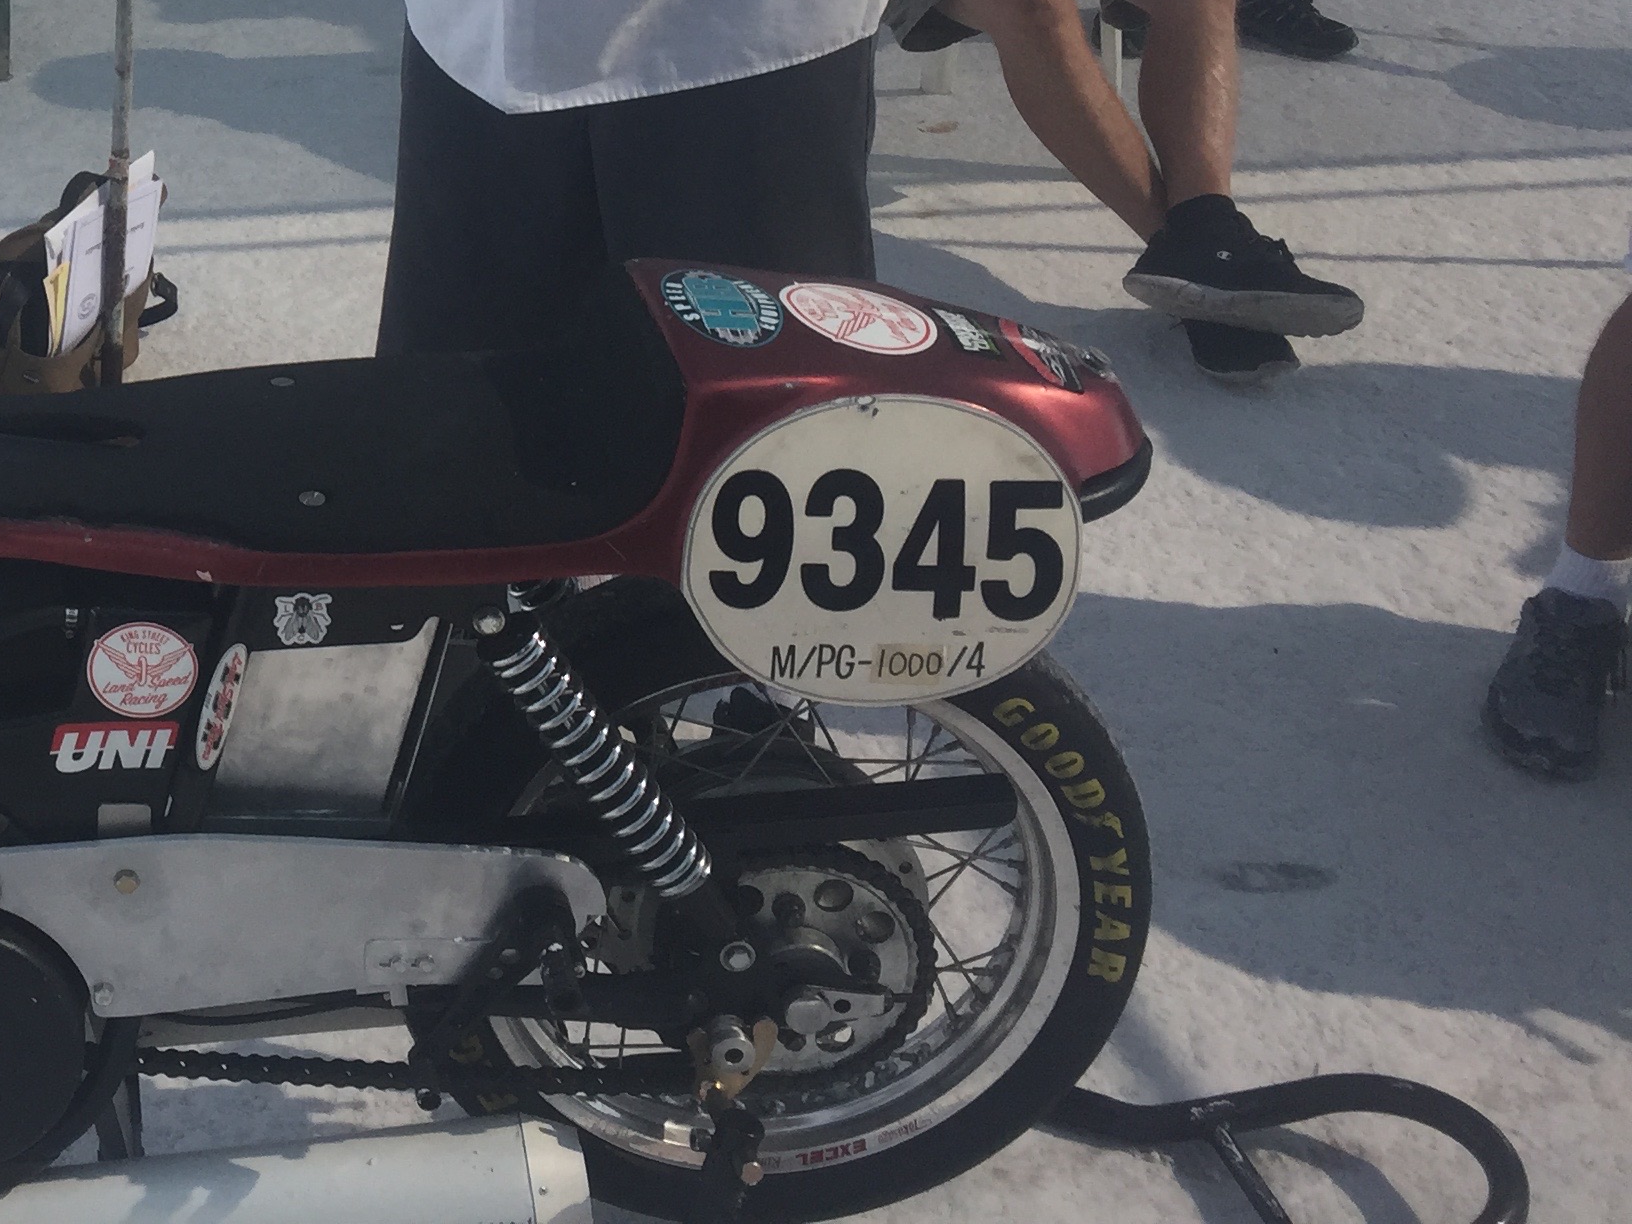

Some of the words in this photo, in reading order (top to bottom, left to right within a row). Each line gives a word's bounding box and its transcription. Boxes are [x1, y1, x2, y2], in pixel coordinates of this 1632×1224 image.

[666, 282, 701, 322] SPEED
[733, 280, 781, 331] EQUIPMENT
[708, 468, 1065, 622] 9345
[120, 630, 140, 643] KING
[141, 630, 170, 645] STREET
[126, 642, 161, 655] CYCLES
[770, 641, 986, 680] M/PG-1000/4
[103, 680, 137, 694] Land
[148, 671, 193, 692] Speed
[119, 692, 168, 710] Racing
[55, 729, 173, 773] UNI
[795, 1138, 867, 1165] EXCEL
